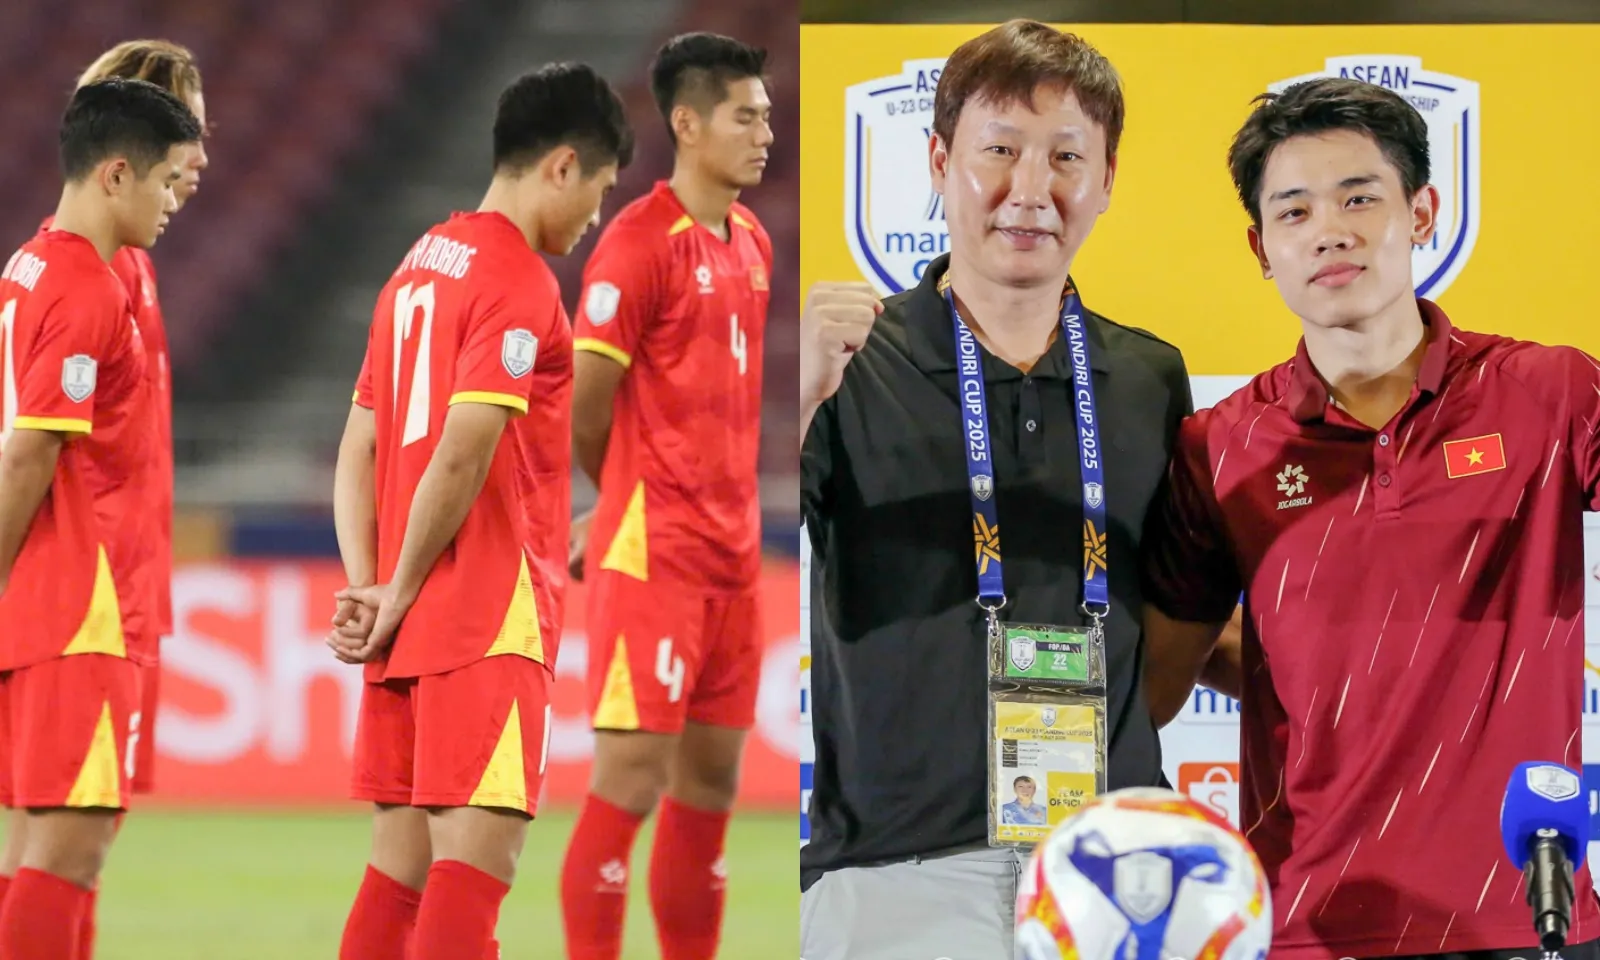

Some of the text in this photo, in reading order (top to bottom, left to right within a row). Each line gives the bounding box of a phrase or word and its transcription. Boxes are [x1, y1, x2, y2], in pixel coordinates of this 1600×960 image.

[886, 99, 915, 116] U-23
[392, 280, 435, 447] 17
[730, 313, 747, 376] 4
[954, 309, 979, 376] ANDIRI
[1064, 314, 1089, 386] MANDIRI
[963, 379, 983, 415] CUP
[1077, 390, 1094, 424] CUP
[968, 419, 987, 462] 2025
[1081, 427, 1098, 469] 2025
[656, 638, 685, 703] 4
[1053, 653, 1068, 666] 22
